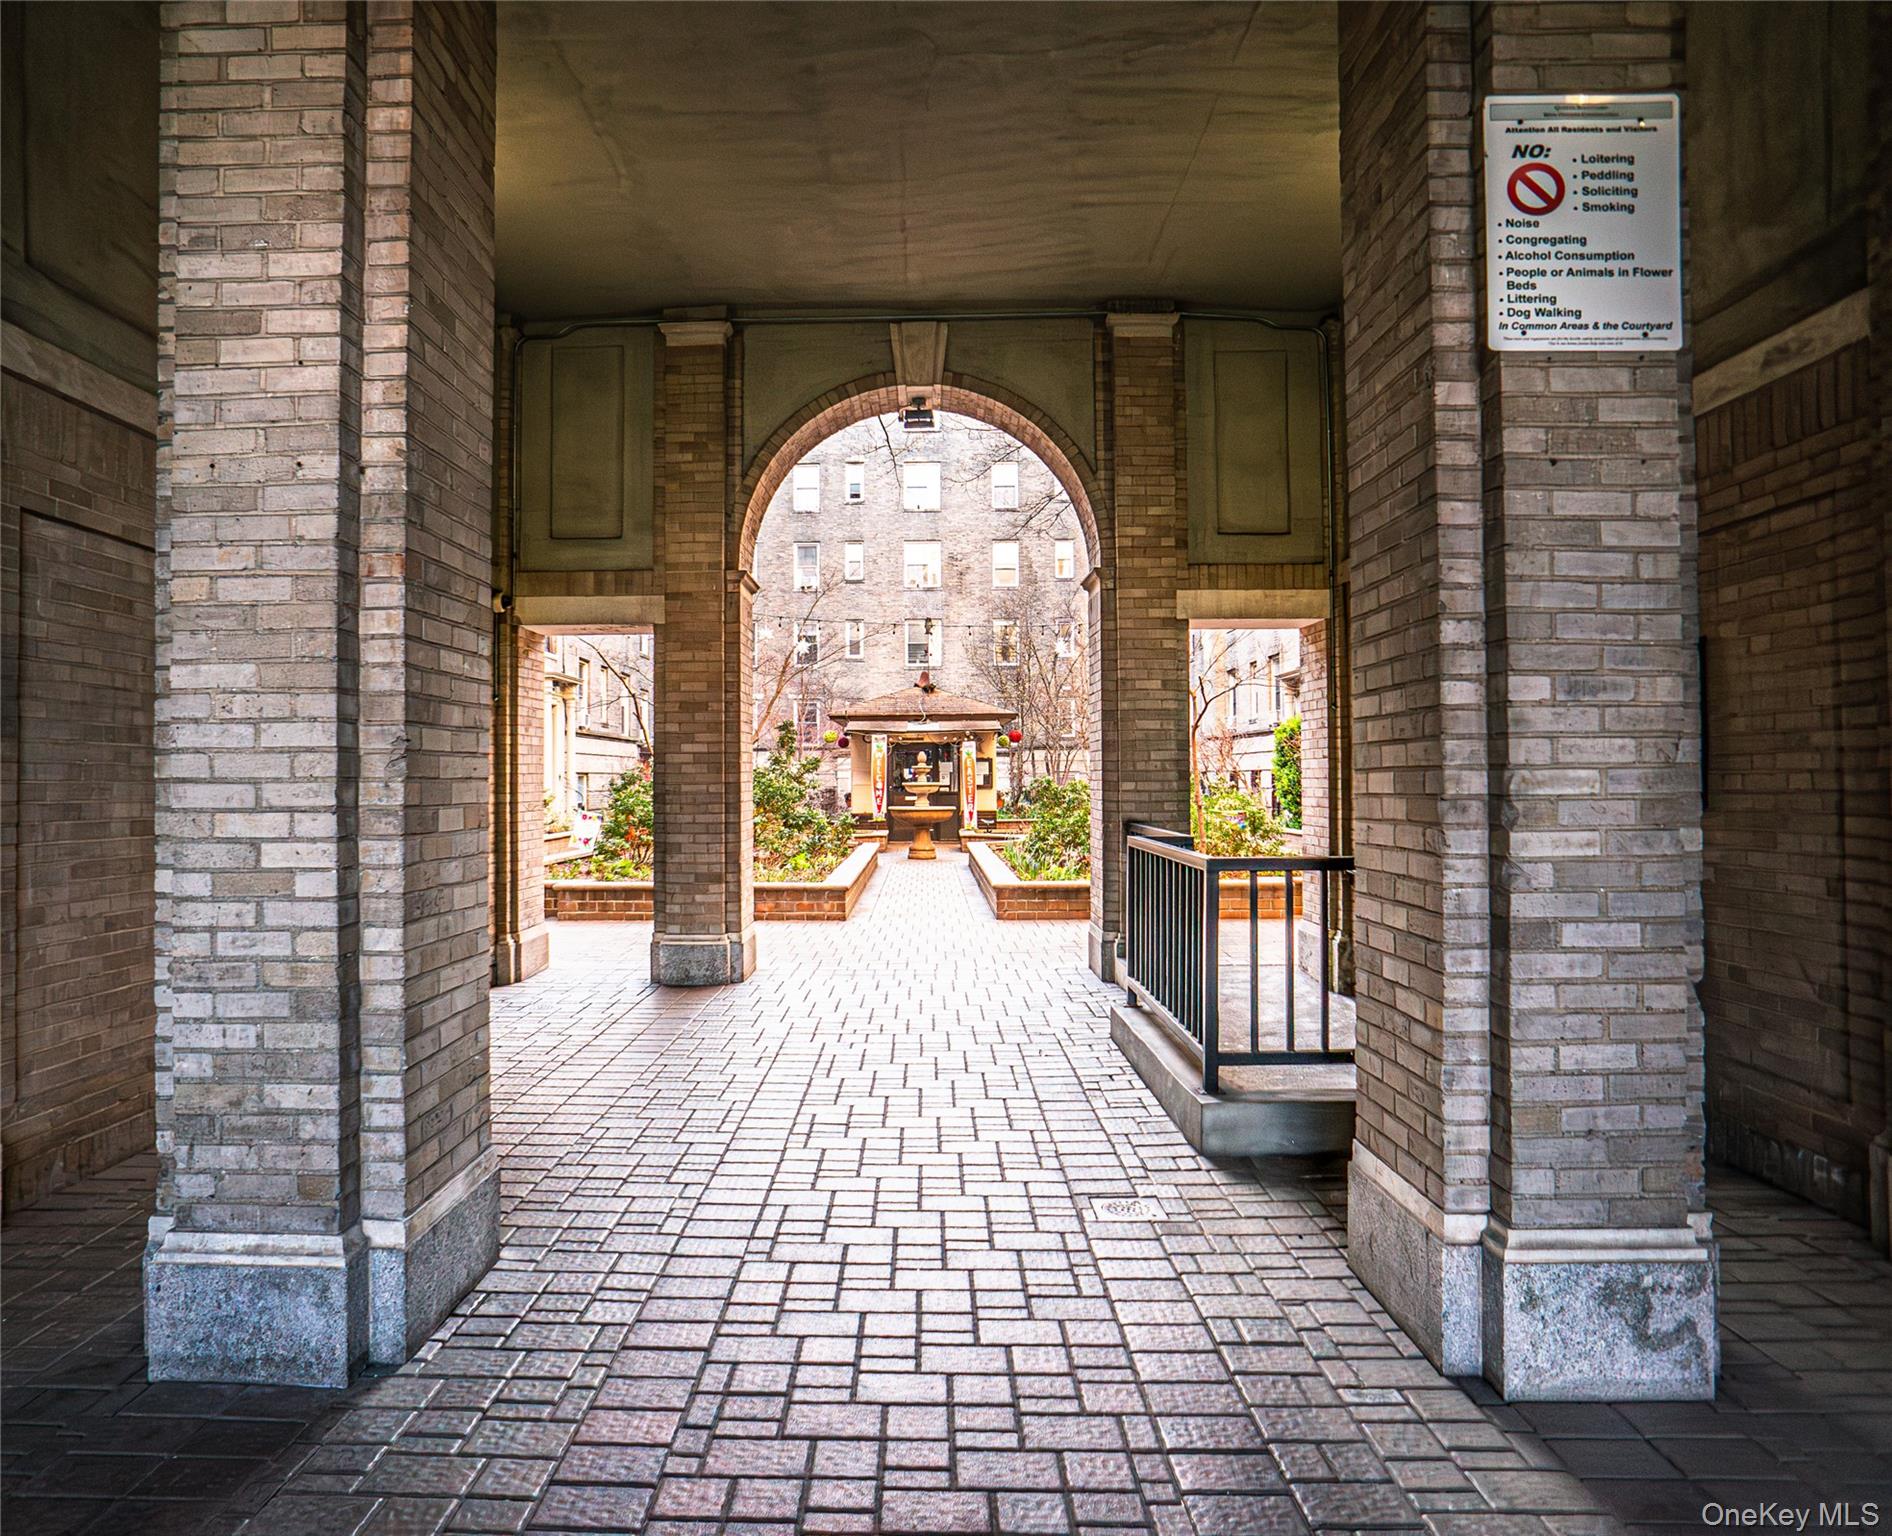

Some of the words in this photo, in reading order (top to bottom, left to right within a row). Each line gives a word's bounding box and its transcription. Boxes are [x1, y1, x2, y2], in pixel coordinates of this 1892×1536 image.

[1505, 126, 1546, 134] Attention
[1511, 144, 1552, 159] NO:
[1581, 153, 1635, 165] Loitering
[1581, 170, 1635, 182] Peddling
[1582, 186, 1639, 198] Soliciting
[1582, 202, 1635, 214] Smoking
[1505, 219, 1540, 229] Noise
[1506, 235, 1587, 247] Congregating
[1505, 250, 1552, 261] Alcohol
[1554, 250, 1635, 262] Consumption
[1506, 267, 1547, 279] People
[1550, 269, 1564, 277] or
[1566, 267, 1614, 277] Animals
[1632, 267, 1673, 277] Flower
[1506, 280, 1537, 291] Beds
[1507, 294, 1557, 305] Littering
[1507, 308, 1531, 319] Dog
[1534, 308, 1582, 319] Walking
[1498, 322, 1509, 330] In
[1511, 321, 1557, 331] Common
[1559, 321, 1590, 330] Areas
[1592, 321, 1600, 330] &
[1603, 321, 1619, 330] the
[1621, 321, 1673, 332] Courtyard
[875, 751, 884, 806] WELCOME
[966, 757, 975, 812] EASTER
